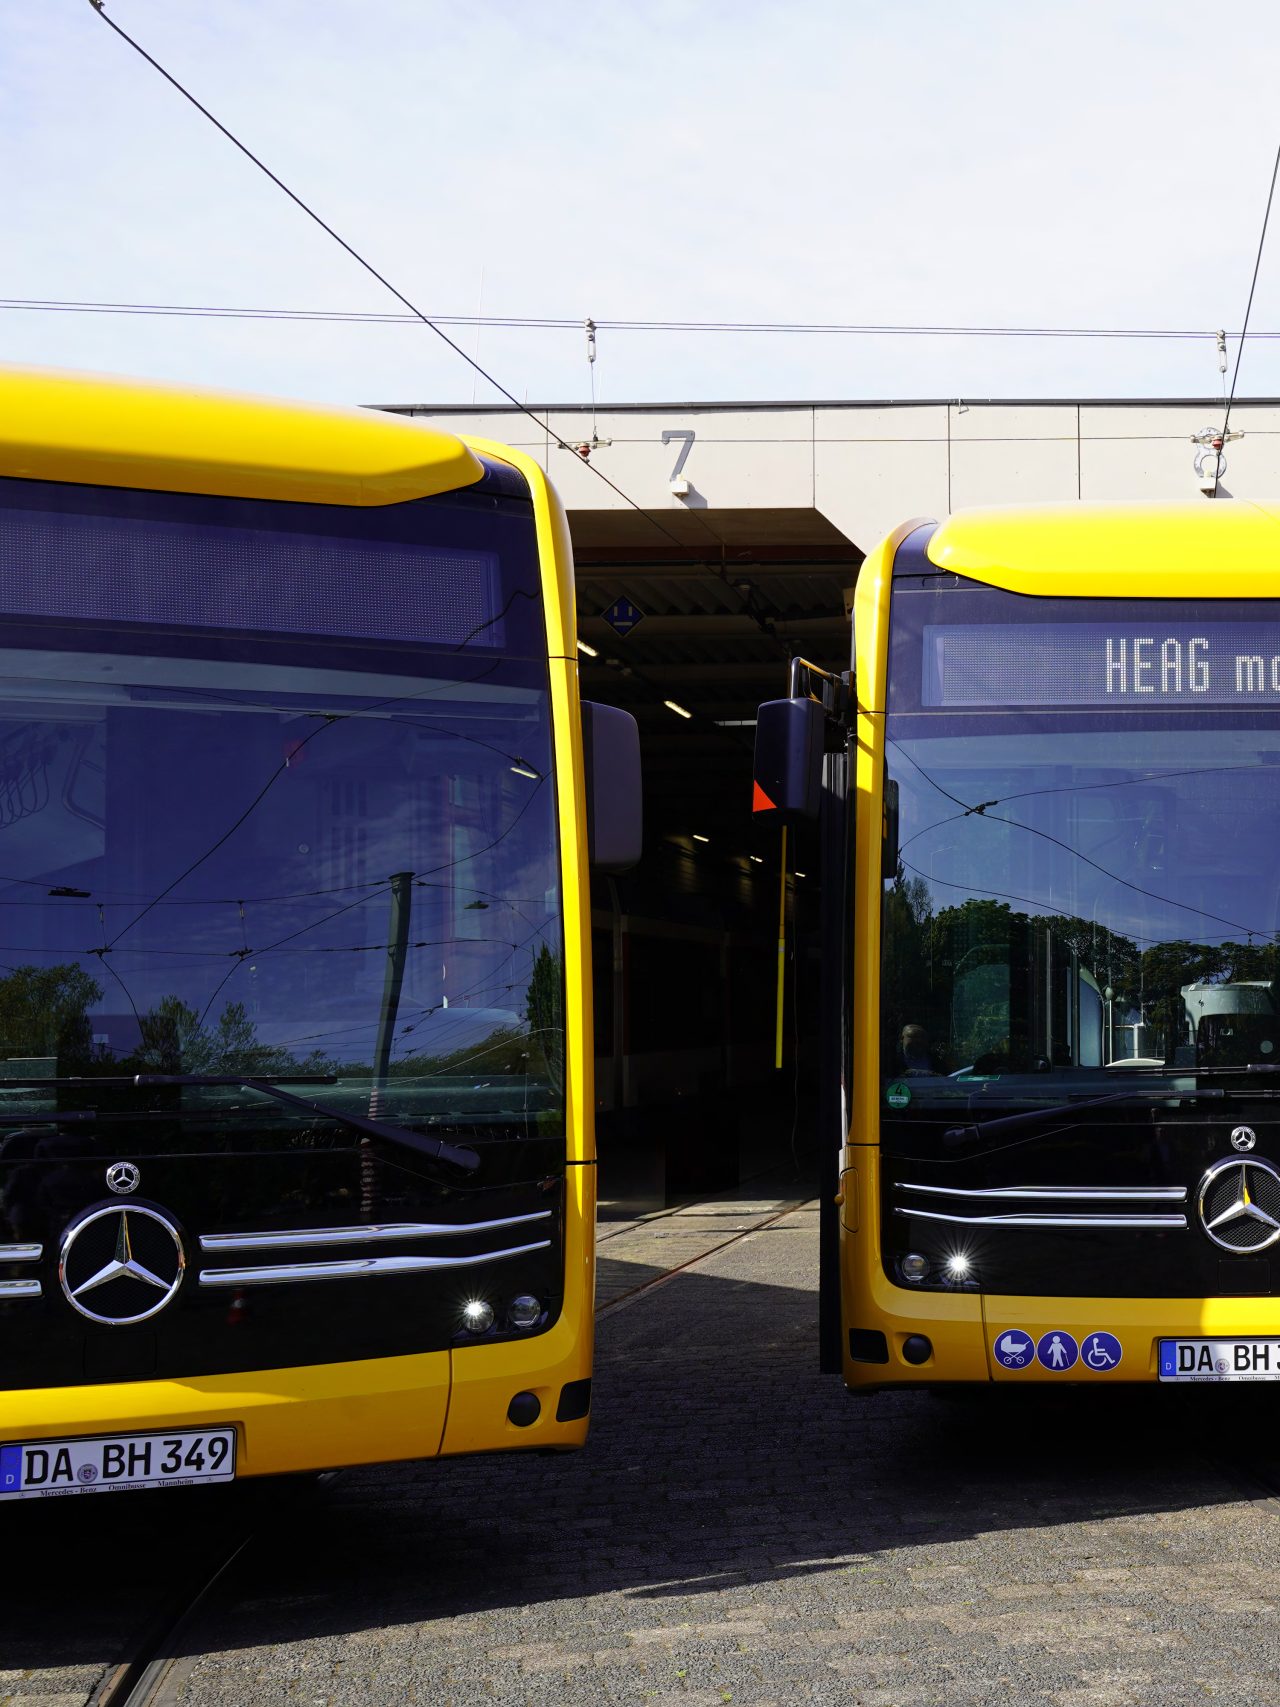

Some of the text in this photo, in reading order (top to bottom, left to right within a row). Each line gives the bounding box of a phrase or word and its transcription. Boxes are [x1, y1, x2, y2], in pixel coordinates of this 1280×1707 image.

[662, 430, 695, 482] 7
[1106, 638, 1209, 692] HEAG
[1165, 1362, 1172, 1371] D
[1178, 1345, 1214, 1372] DA
[1234, 1344, 1269, 1371] BH
[25, 1436, 229, 1485] DA BH 349
[5, 1474, 14, 1485] D
[158, 1478, 194, 1487] Mannheim
